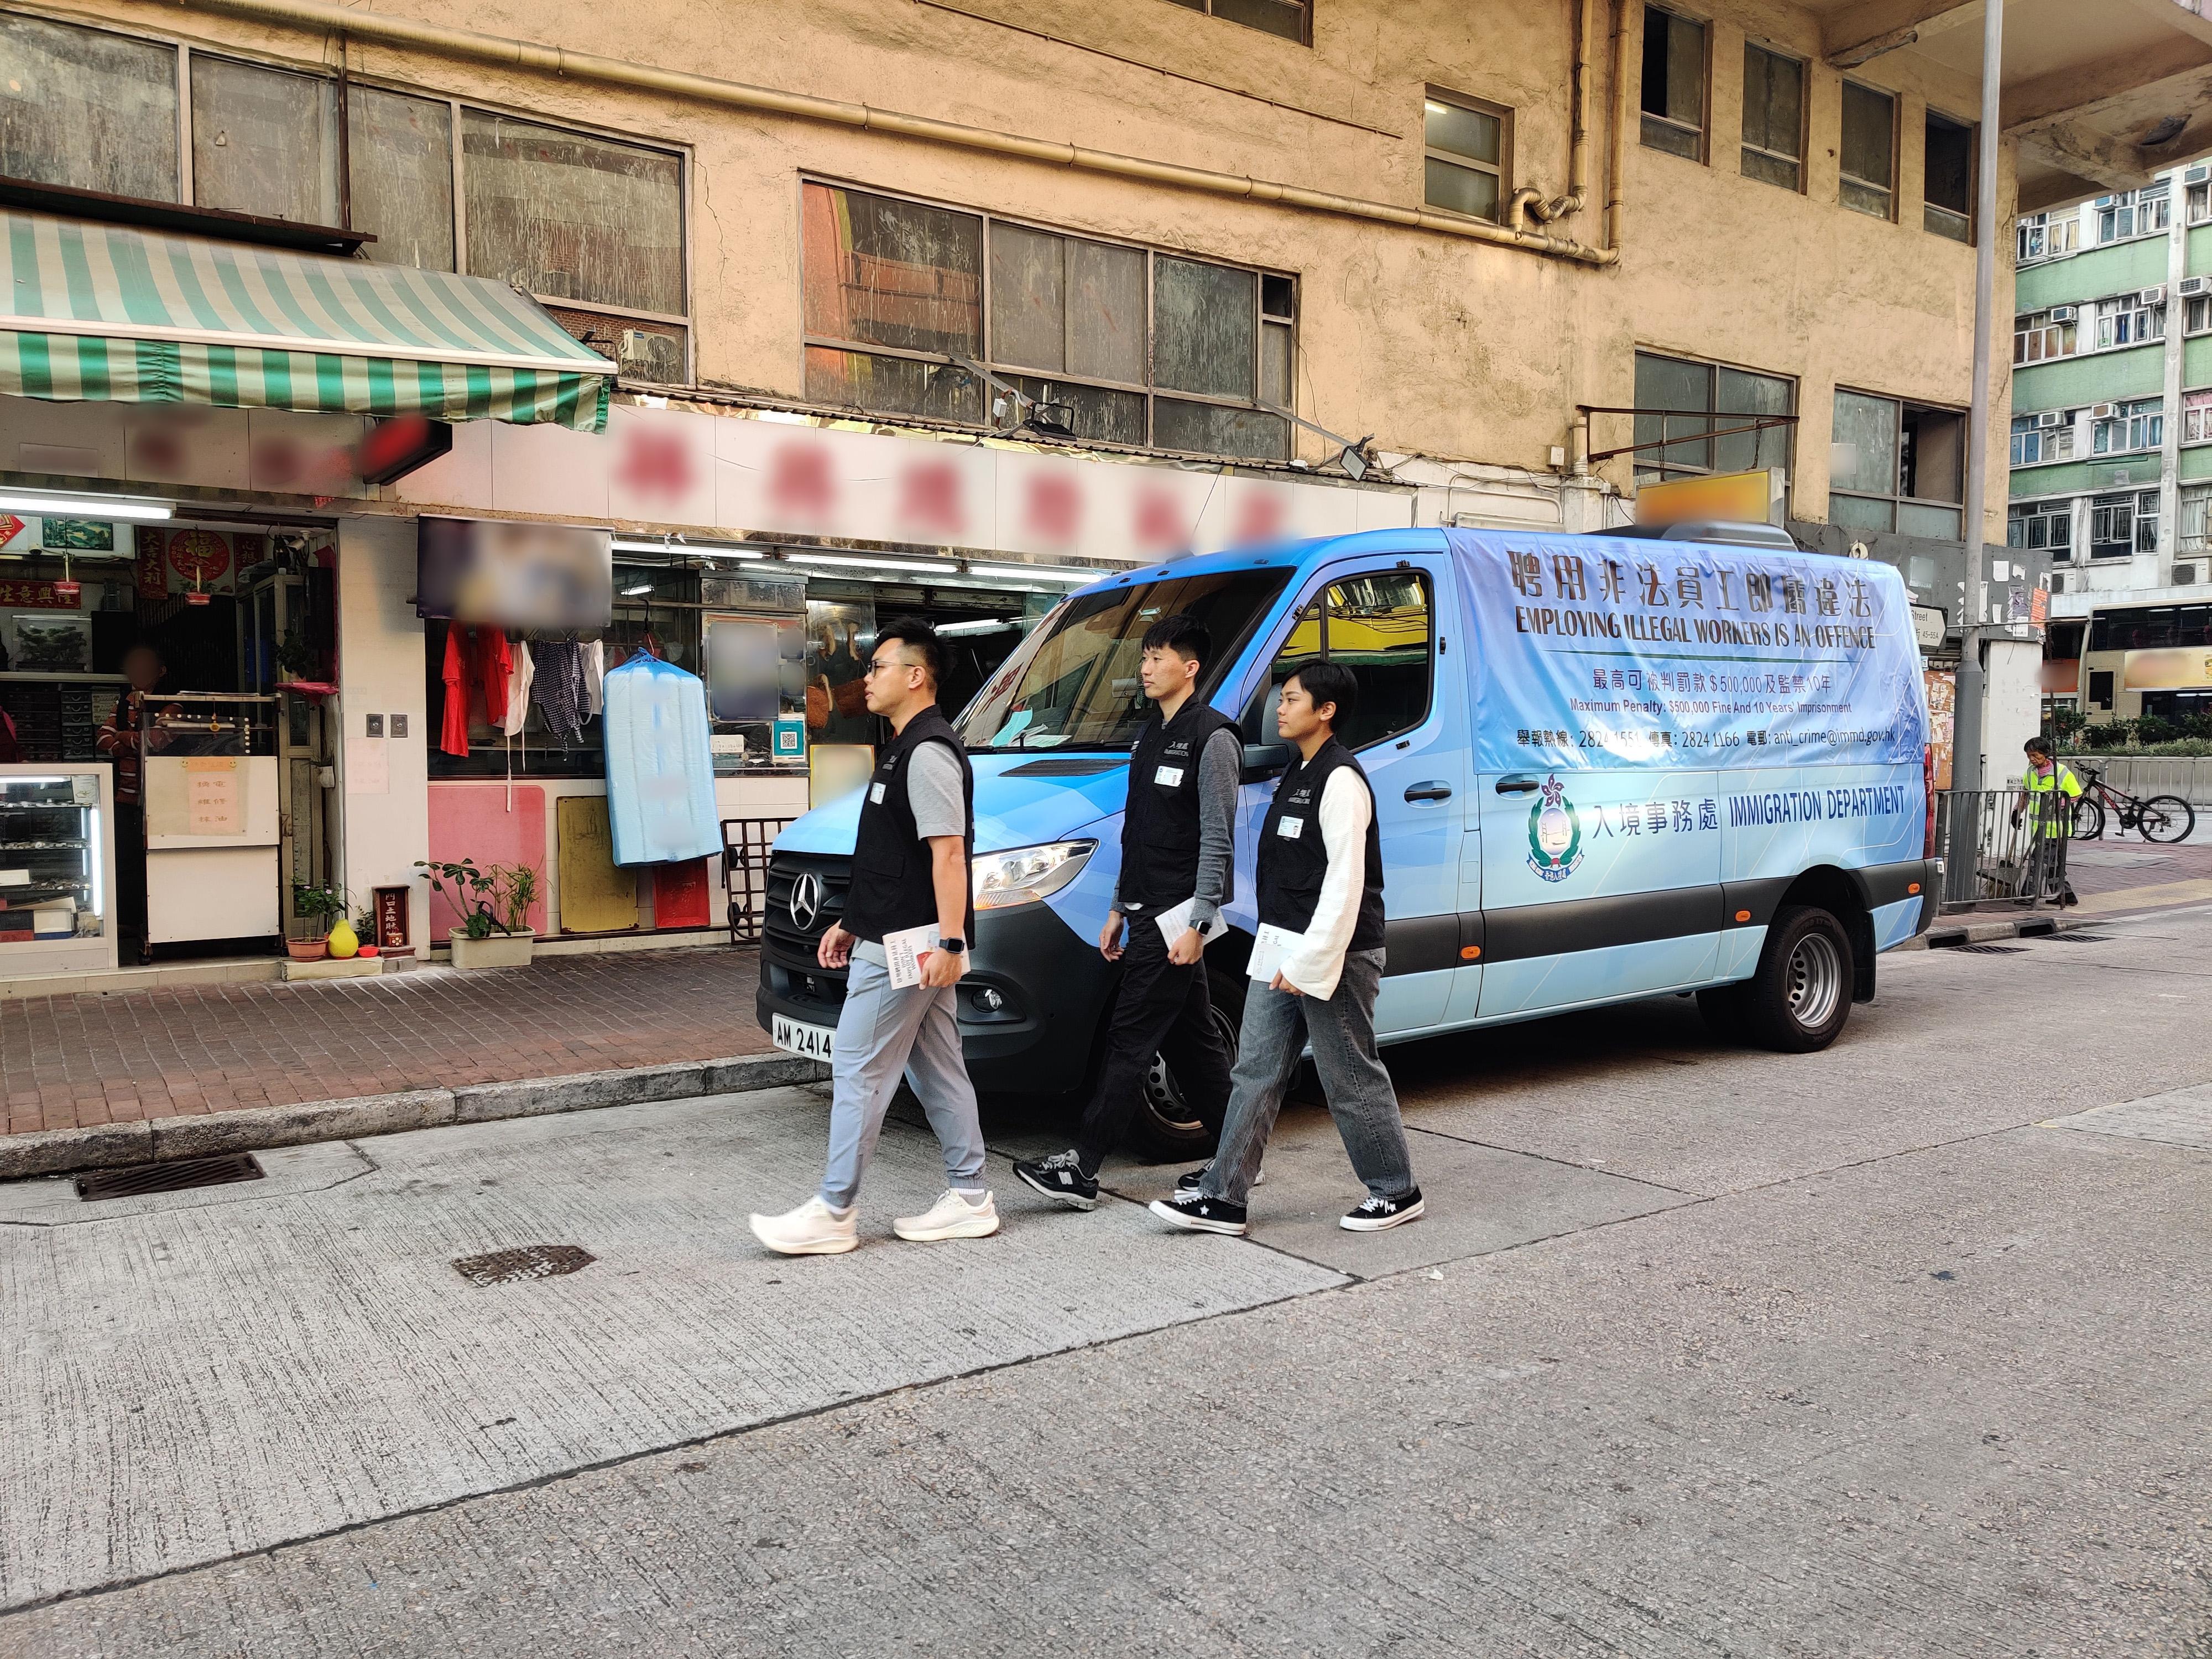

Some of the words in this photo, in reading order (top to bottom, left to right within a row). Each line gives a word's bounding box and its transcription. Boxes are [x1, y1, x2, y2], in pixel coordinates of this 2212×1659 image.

[143, 531, 161, 585] 大吉大利
[184, 530, 216, 558] 福
[1506, 550, 1872, 618] 聘用非法員工即屬違法
[1515, 606, 1622, 638] EMPLOYING
[1624, 614, 1692, 643] ILLEGAL
[1694, 619, 1770, 646] WORKERS
[1774, 623, 1790, 647] IS
[1794, 623, 1811, 648] AN
[1815, 624, 1876, 649] OFFENCE
[1911, 609, 1928, 622] Street
[1922, 631, 1939, 639] 45-55A
[1570, 698, 1620, 712] Maximum
[1623, 699, 1667, 716] Penalty:
[1669, 700, 1709, 715] $500,000
[1712, 701, 1732, 714] Fine
[1734, 702, 1751, 714] And
[1754, 703, 1764, 713] 10
[1767, 701, 1795, 713] Years'
[1797, 701, 1853, 716] Imprisonment
[1579, 731, 1608, 748] 2824
[1648, 730, 1678, 747] 傳真:
[1682, 731, 1710, 747] 2824
[1713, 731, 1740, 747] 1166
[1774, 726, 1896, 747] anti_crime@immd.gov.hk
[1593, 798, 1718, 839] 入境事務處
[1728, 791, 1822, 827] IMMIGRATION
[1827, 785, 1905, 820] DEPARTMENT
[777, 1021, 791, 1048] AM
[796, 1027, 832, 1058] 2414
